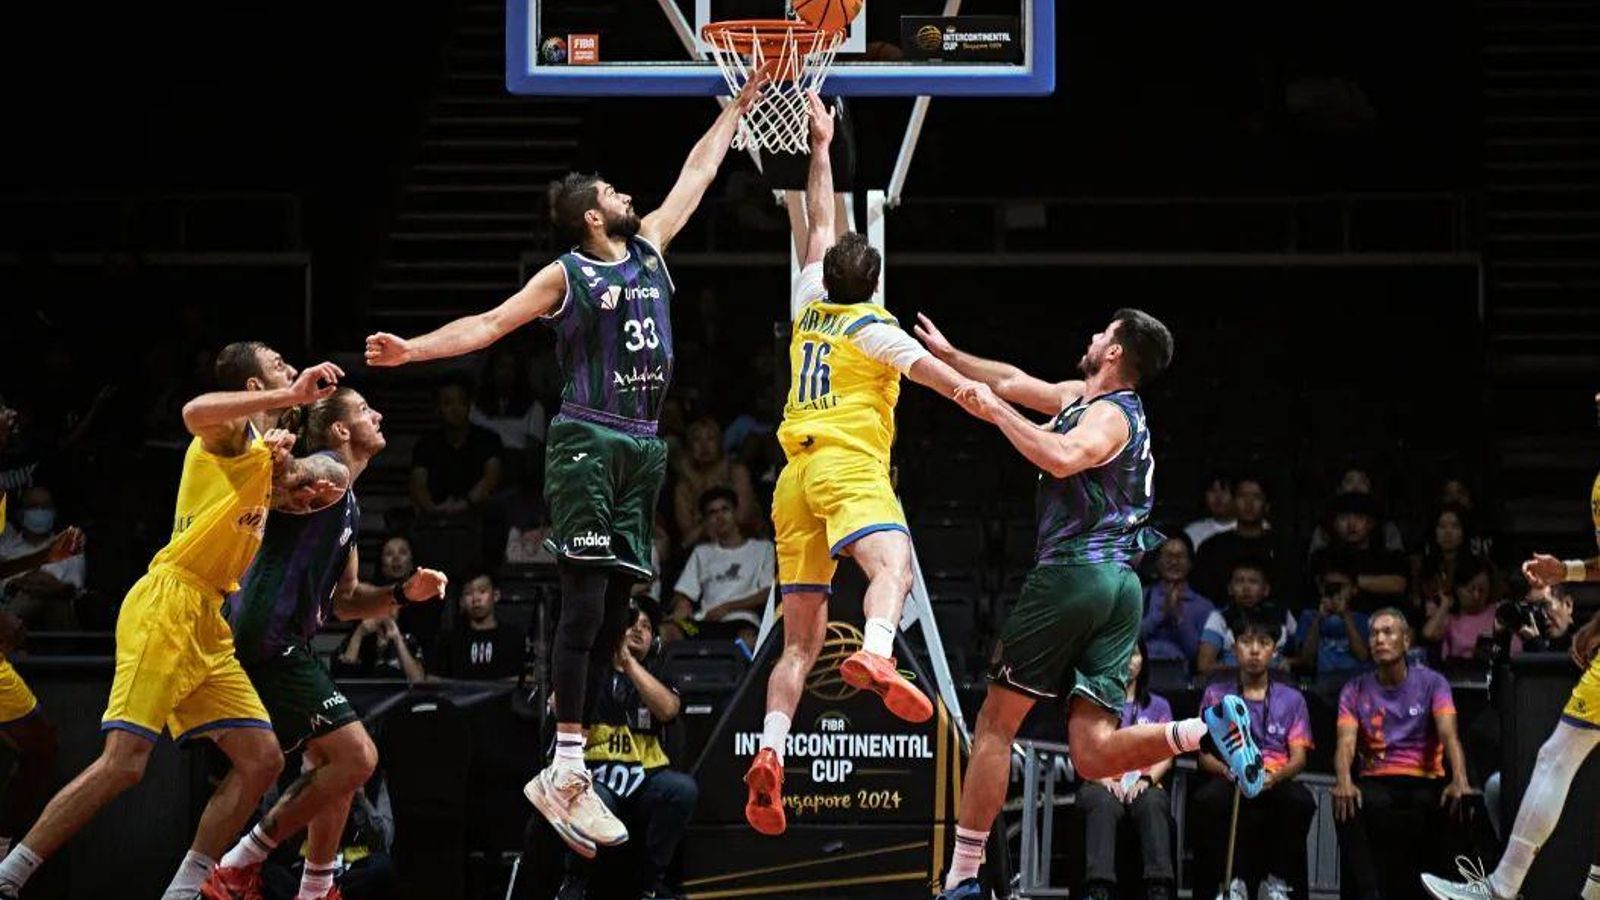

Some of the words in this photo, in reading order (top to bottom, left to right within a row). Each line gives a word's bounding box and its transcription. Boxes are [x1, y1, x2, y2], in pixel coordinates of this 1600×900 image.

[574, 38, 595, 49] FIBA
[943, 42, 958, 51] CUP
[624, 316, 660, 352] 33
[798, 341, 832, 403] 16
[821, 718, 845, 731] FIBA
[608, 733, 632, 754] HB
[734, 732, 933, 759] INTRCONTINENTAL
[592, 764, 646, 798] 107
[811, 760, 853, 783] CUP
[782, 792, 852, 816] ngapore
[857, 789, 903, 810] 2024
